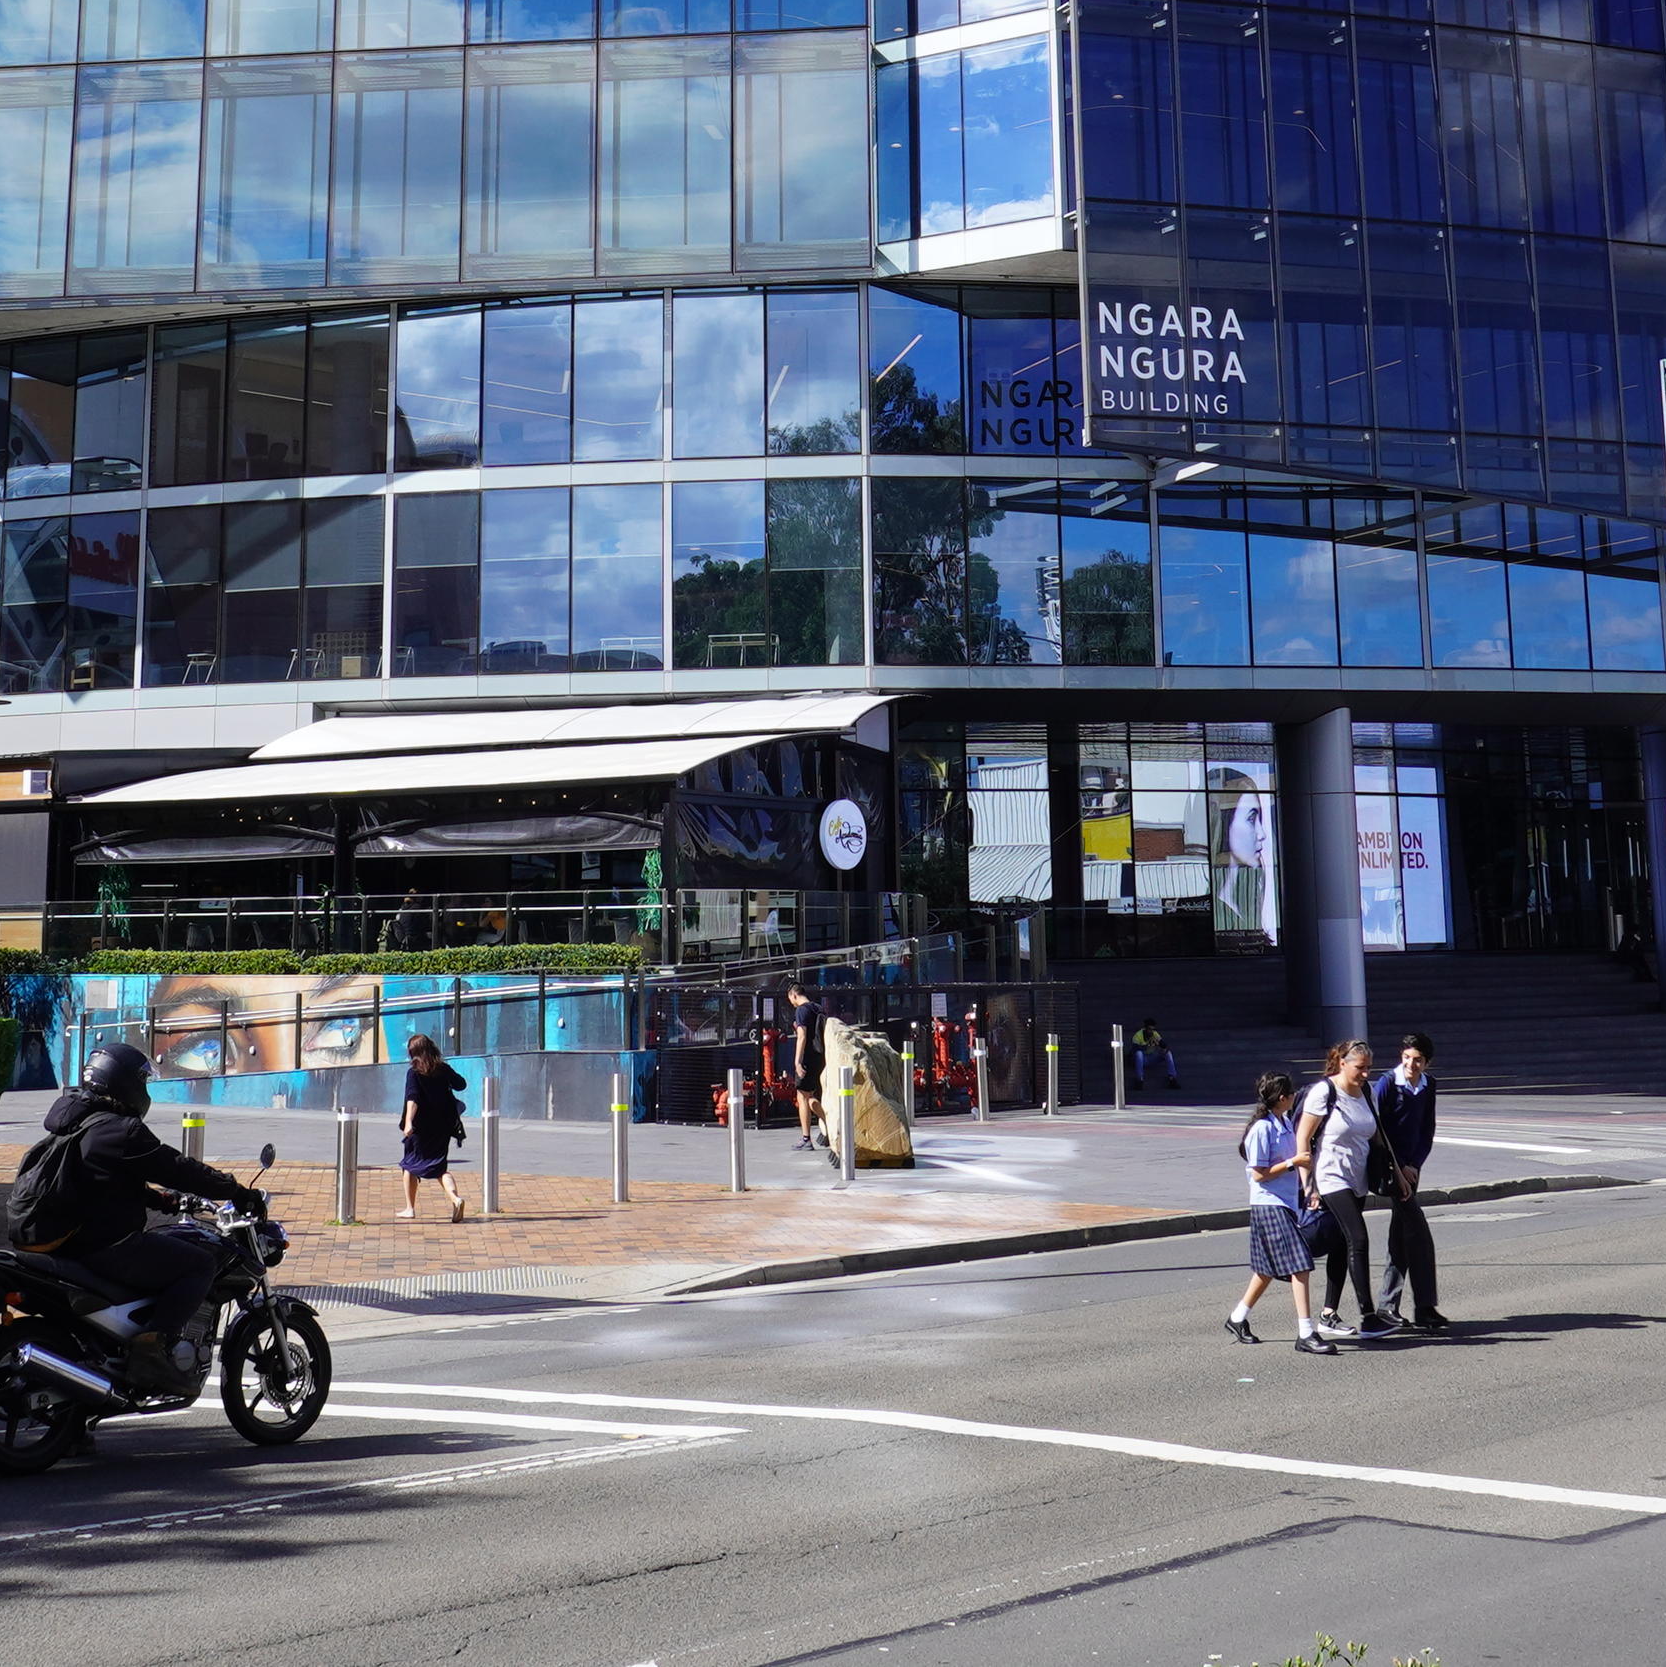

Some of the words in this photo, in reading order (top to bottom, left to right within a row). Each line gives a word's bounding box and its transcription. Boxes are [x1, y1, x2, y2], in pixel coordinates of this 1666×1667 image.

[1098, 301, 1245, 341] NGARA
[1100, 345, 1247, 384] NGURA
[1101, 389, 1229, 415] BUILDING
